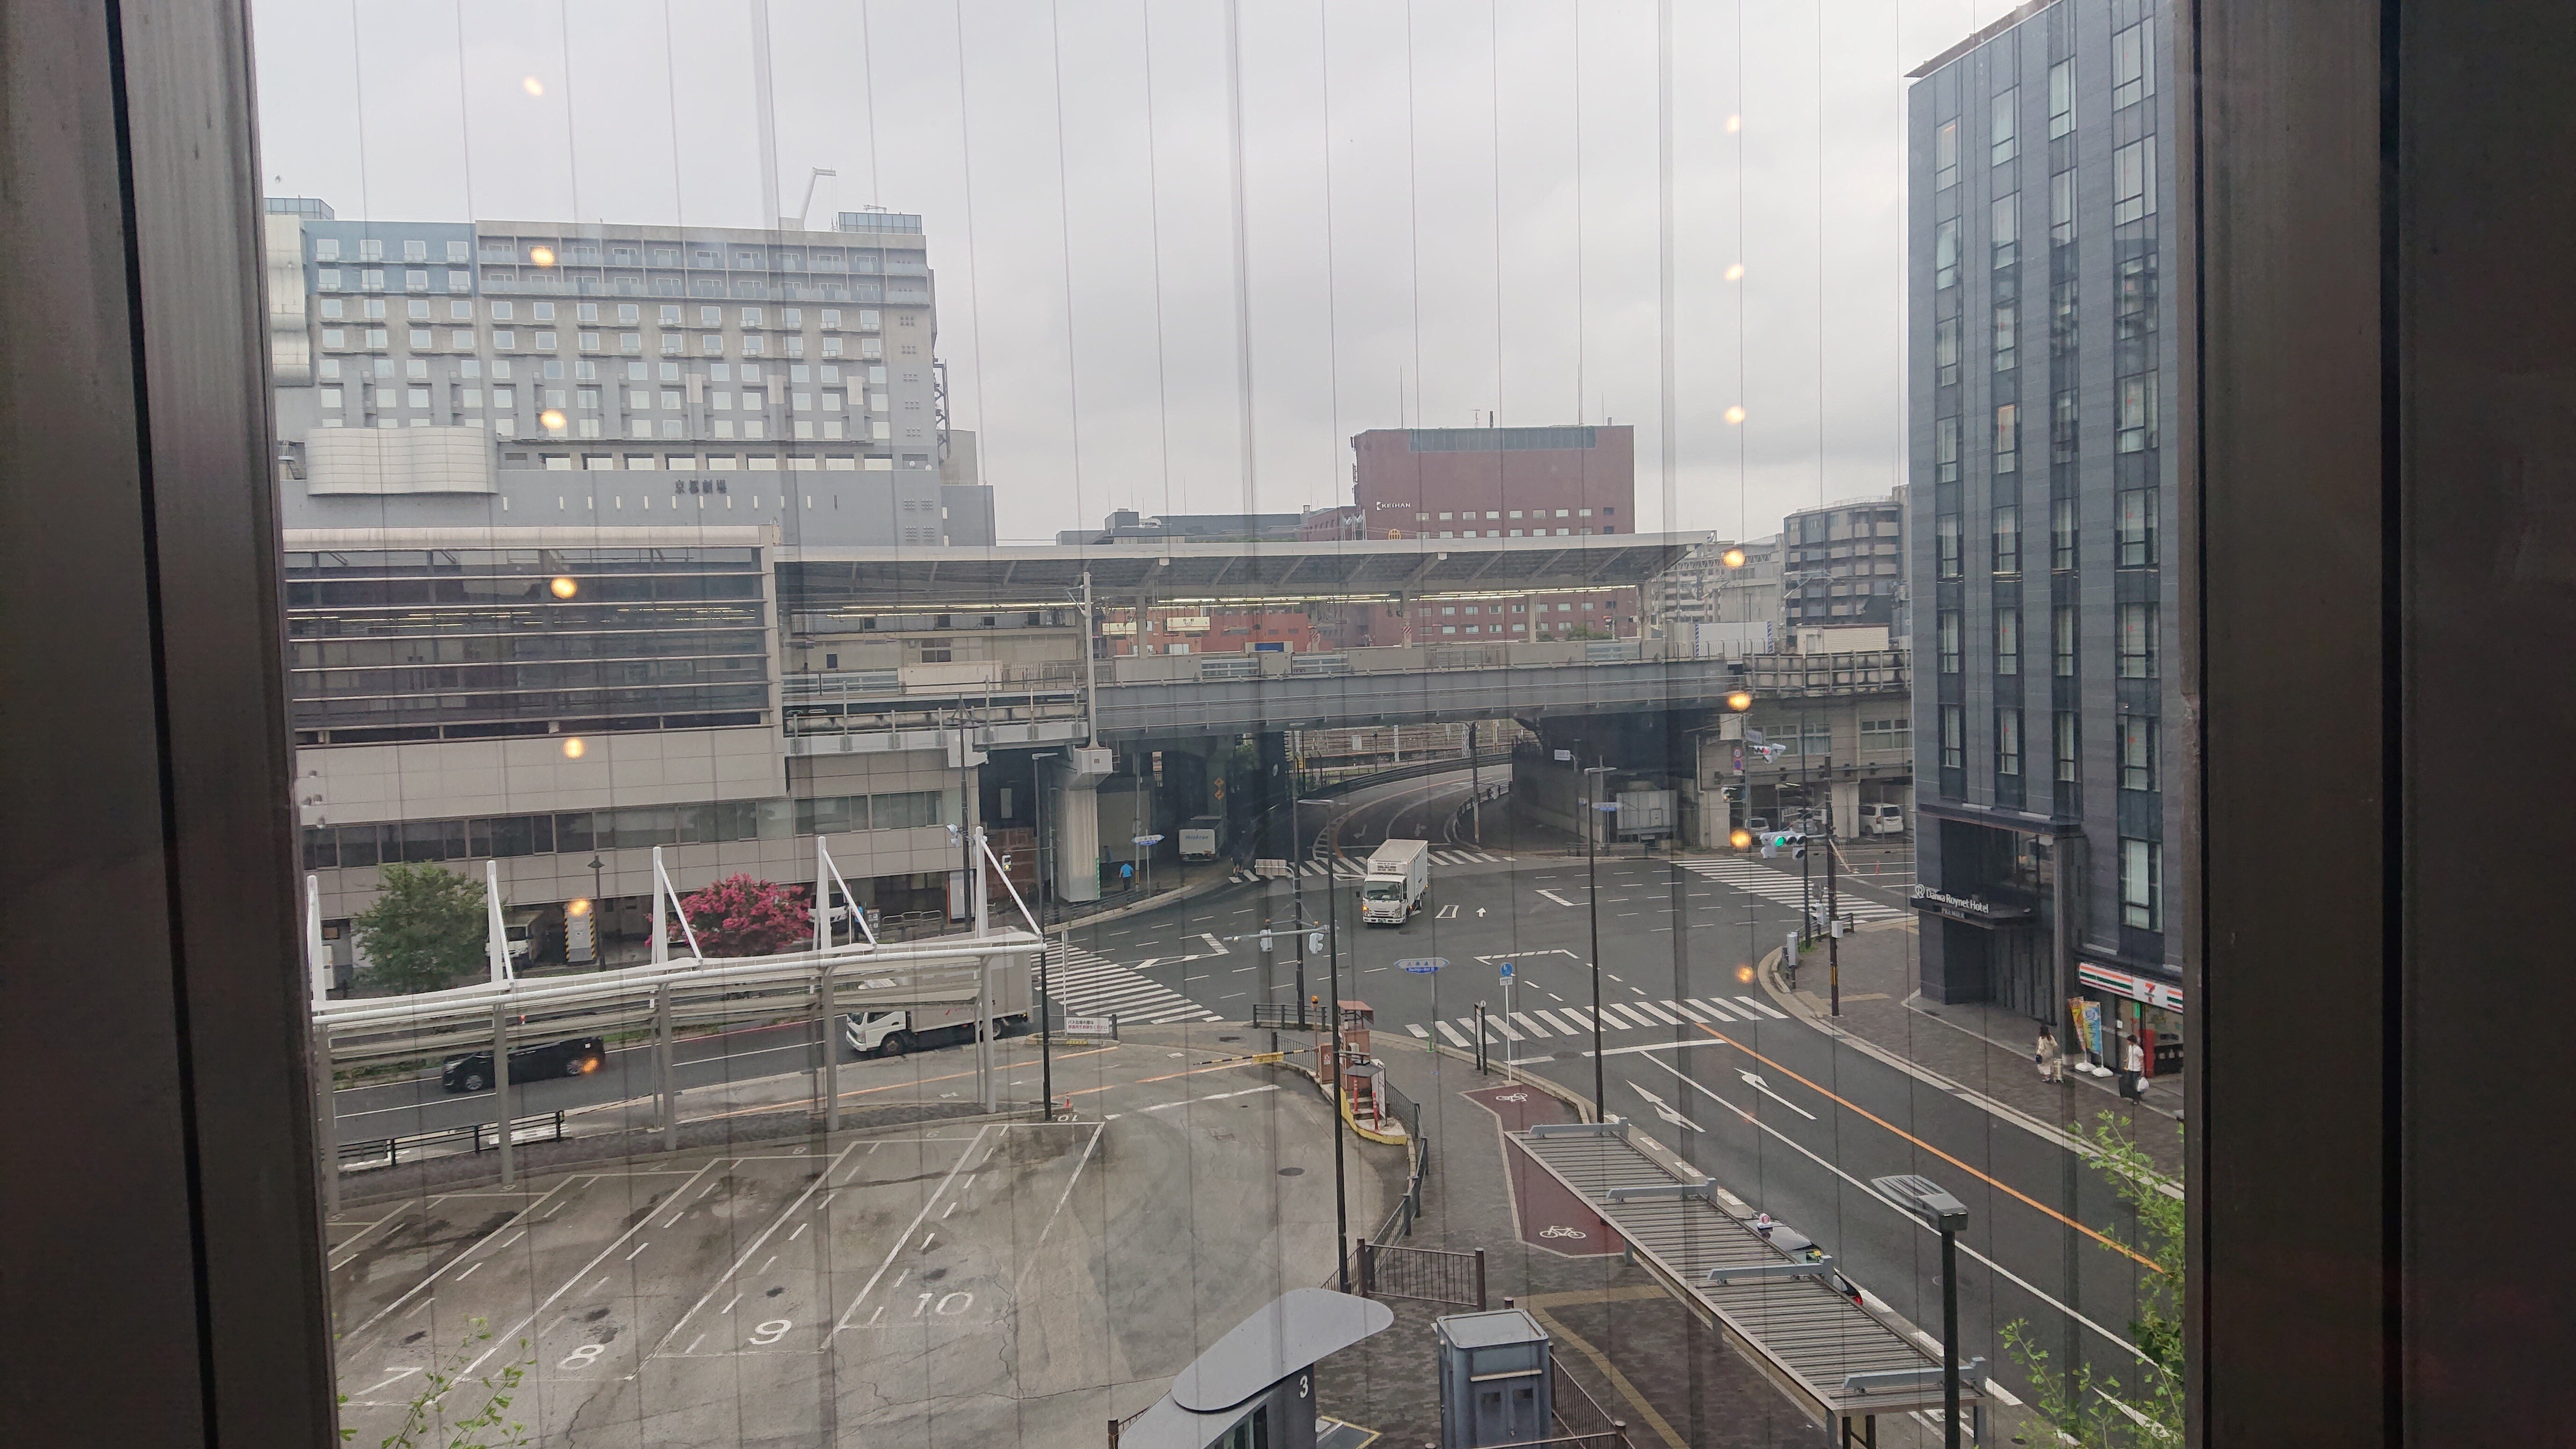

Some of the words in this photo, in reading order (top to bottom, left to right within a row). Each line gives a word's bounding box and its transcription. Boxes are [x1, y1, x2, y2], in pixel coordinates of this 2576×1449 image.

[675, 479, 727, 494] 京都劇場
[1926, 889, 1946, 902] Daiwa
[1946, 894, 1969, 908] Roynet
[1970, 900, 1989, 914] Hotel
[1942, 907, 1966, 919] PREMIER
[2145, 983, 2156, 1003] 7
[912, 1292, 973, 1317] 10
[748, 1319, 792, 1345] 9
[556, 1344, 605, 1369] 8
[354, 1367, 423, 1396] 7
[1300, 1375, 1309, 1398] 3
